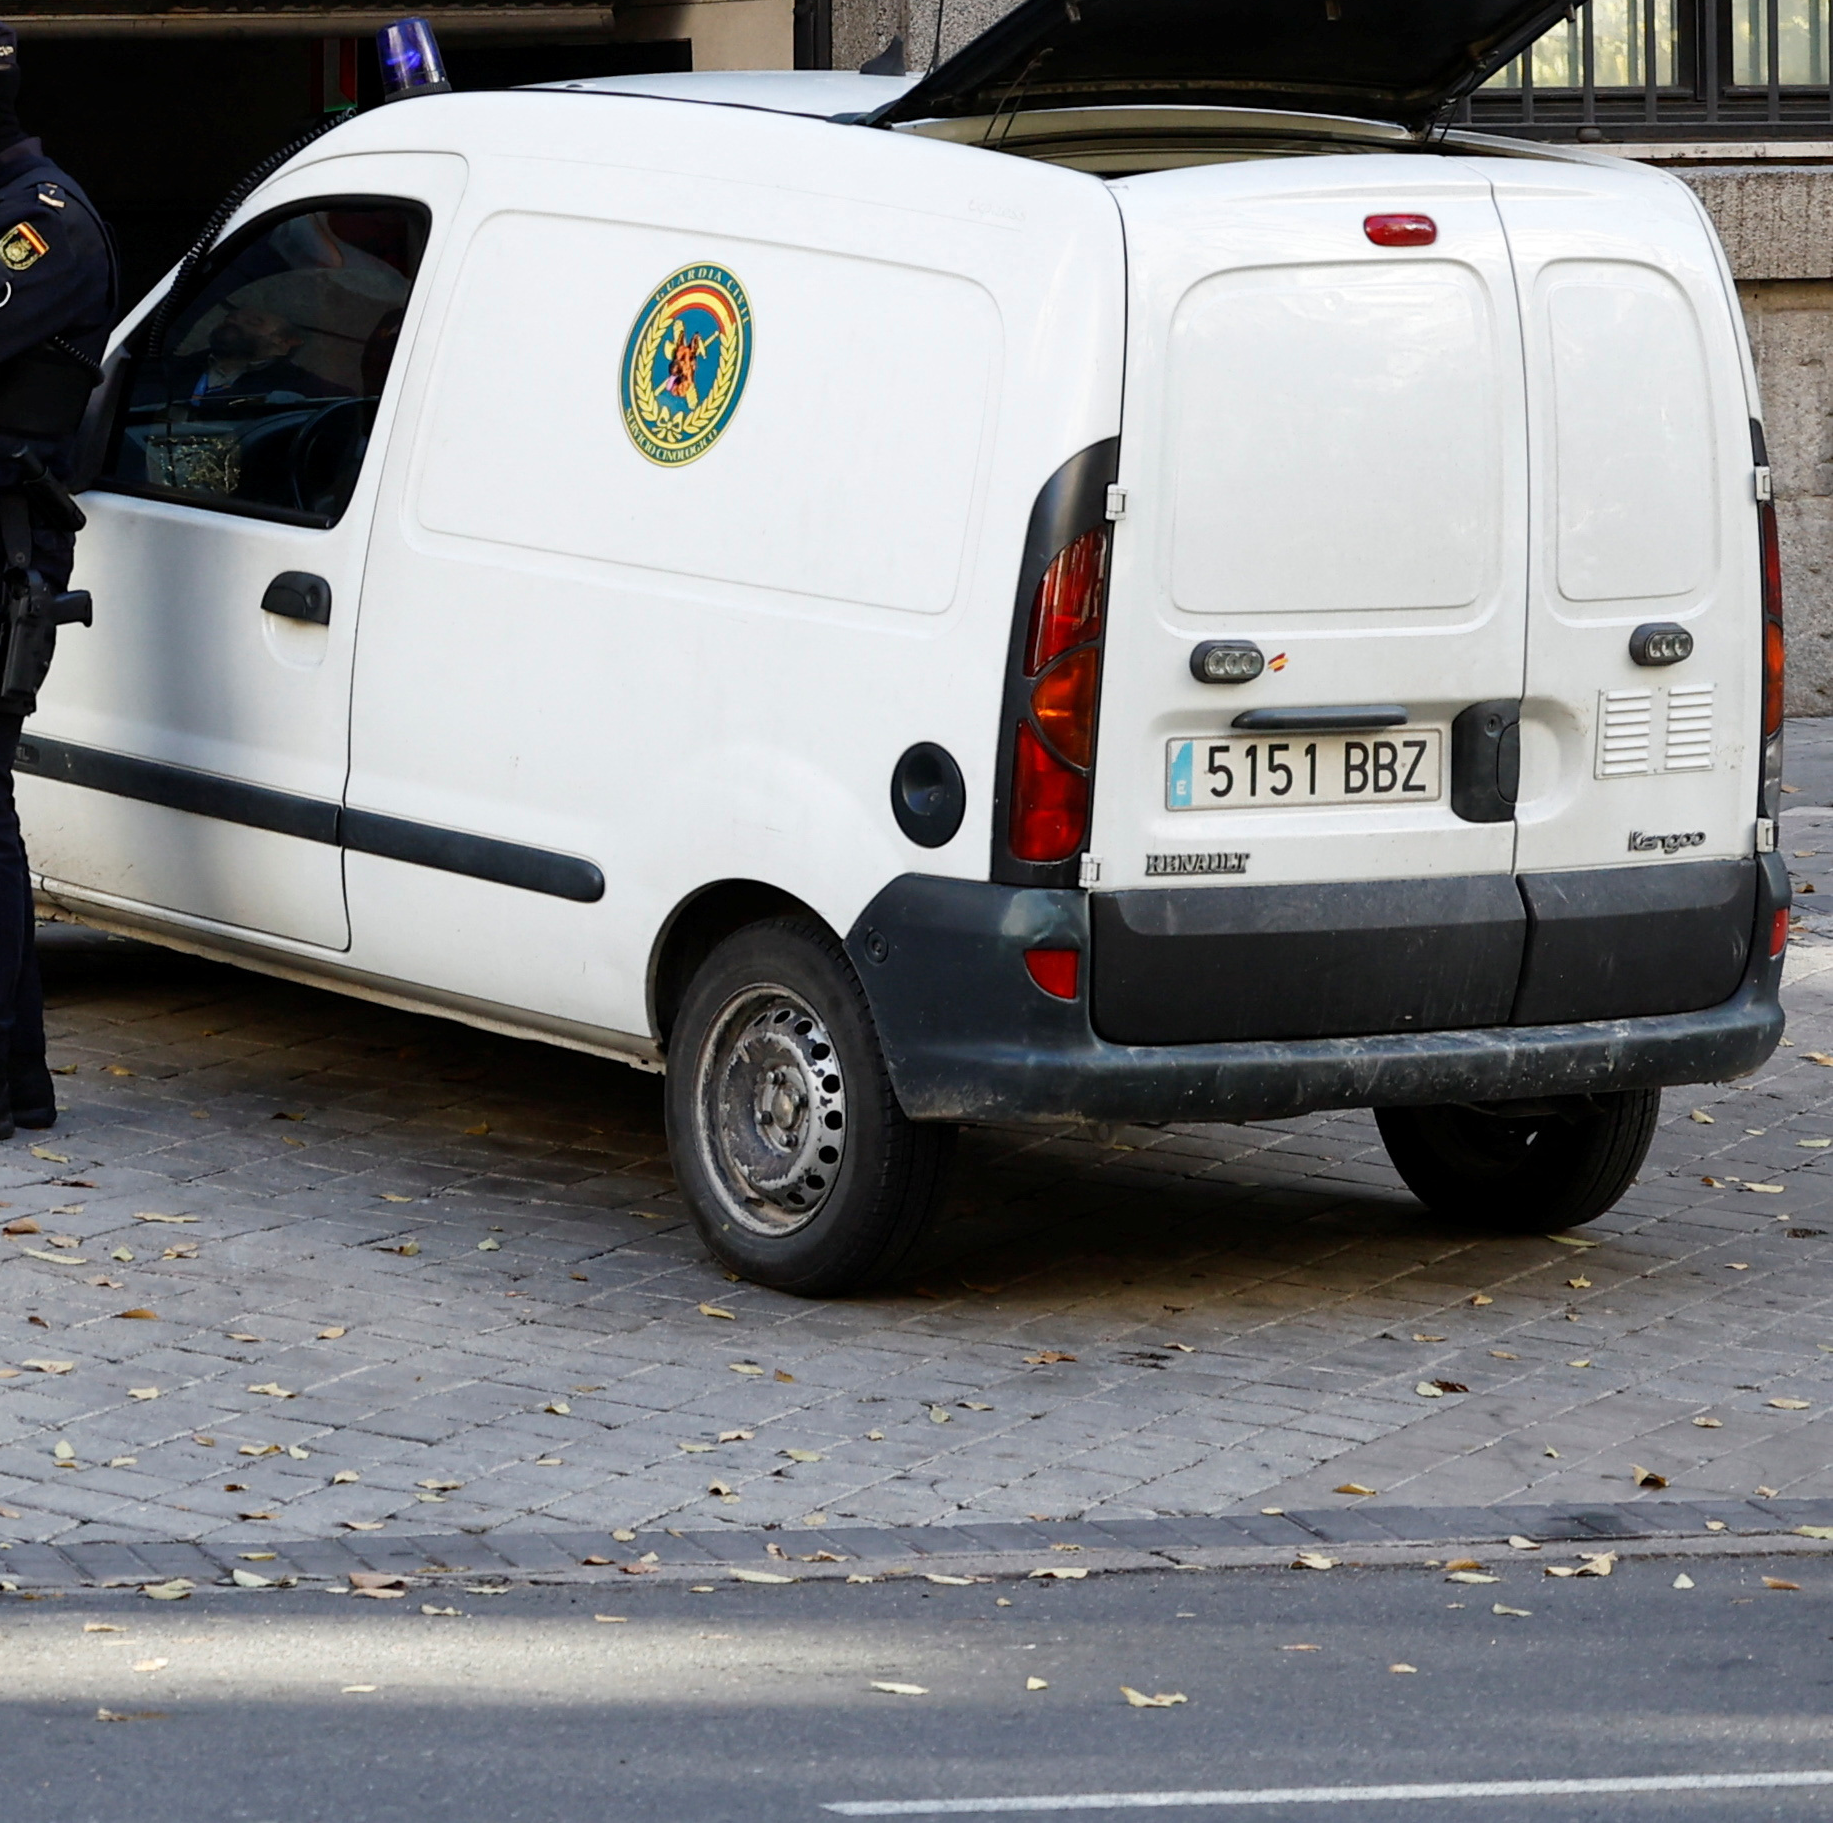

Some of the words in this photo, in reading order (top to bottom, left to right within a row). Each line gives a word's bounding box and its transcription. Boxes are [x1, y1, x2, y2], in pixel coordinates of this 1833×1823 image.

[655, 267, 722, 302] GUARDIA
[727, 280, 751, 327] CIVIL
[625, 407, 656, 456] SERVICIO
[1176, 779, 1187, 795] E
[1208, 742, 1318, 798] 5151
[1344, 740, 1427, 794] BBZ
[1627, 830, 1707, 855] Kangoo
[1145, 852, 1251, 876] RENAULT
